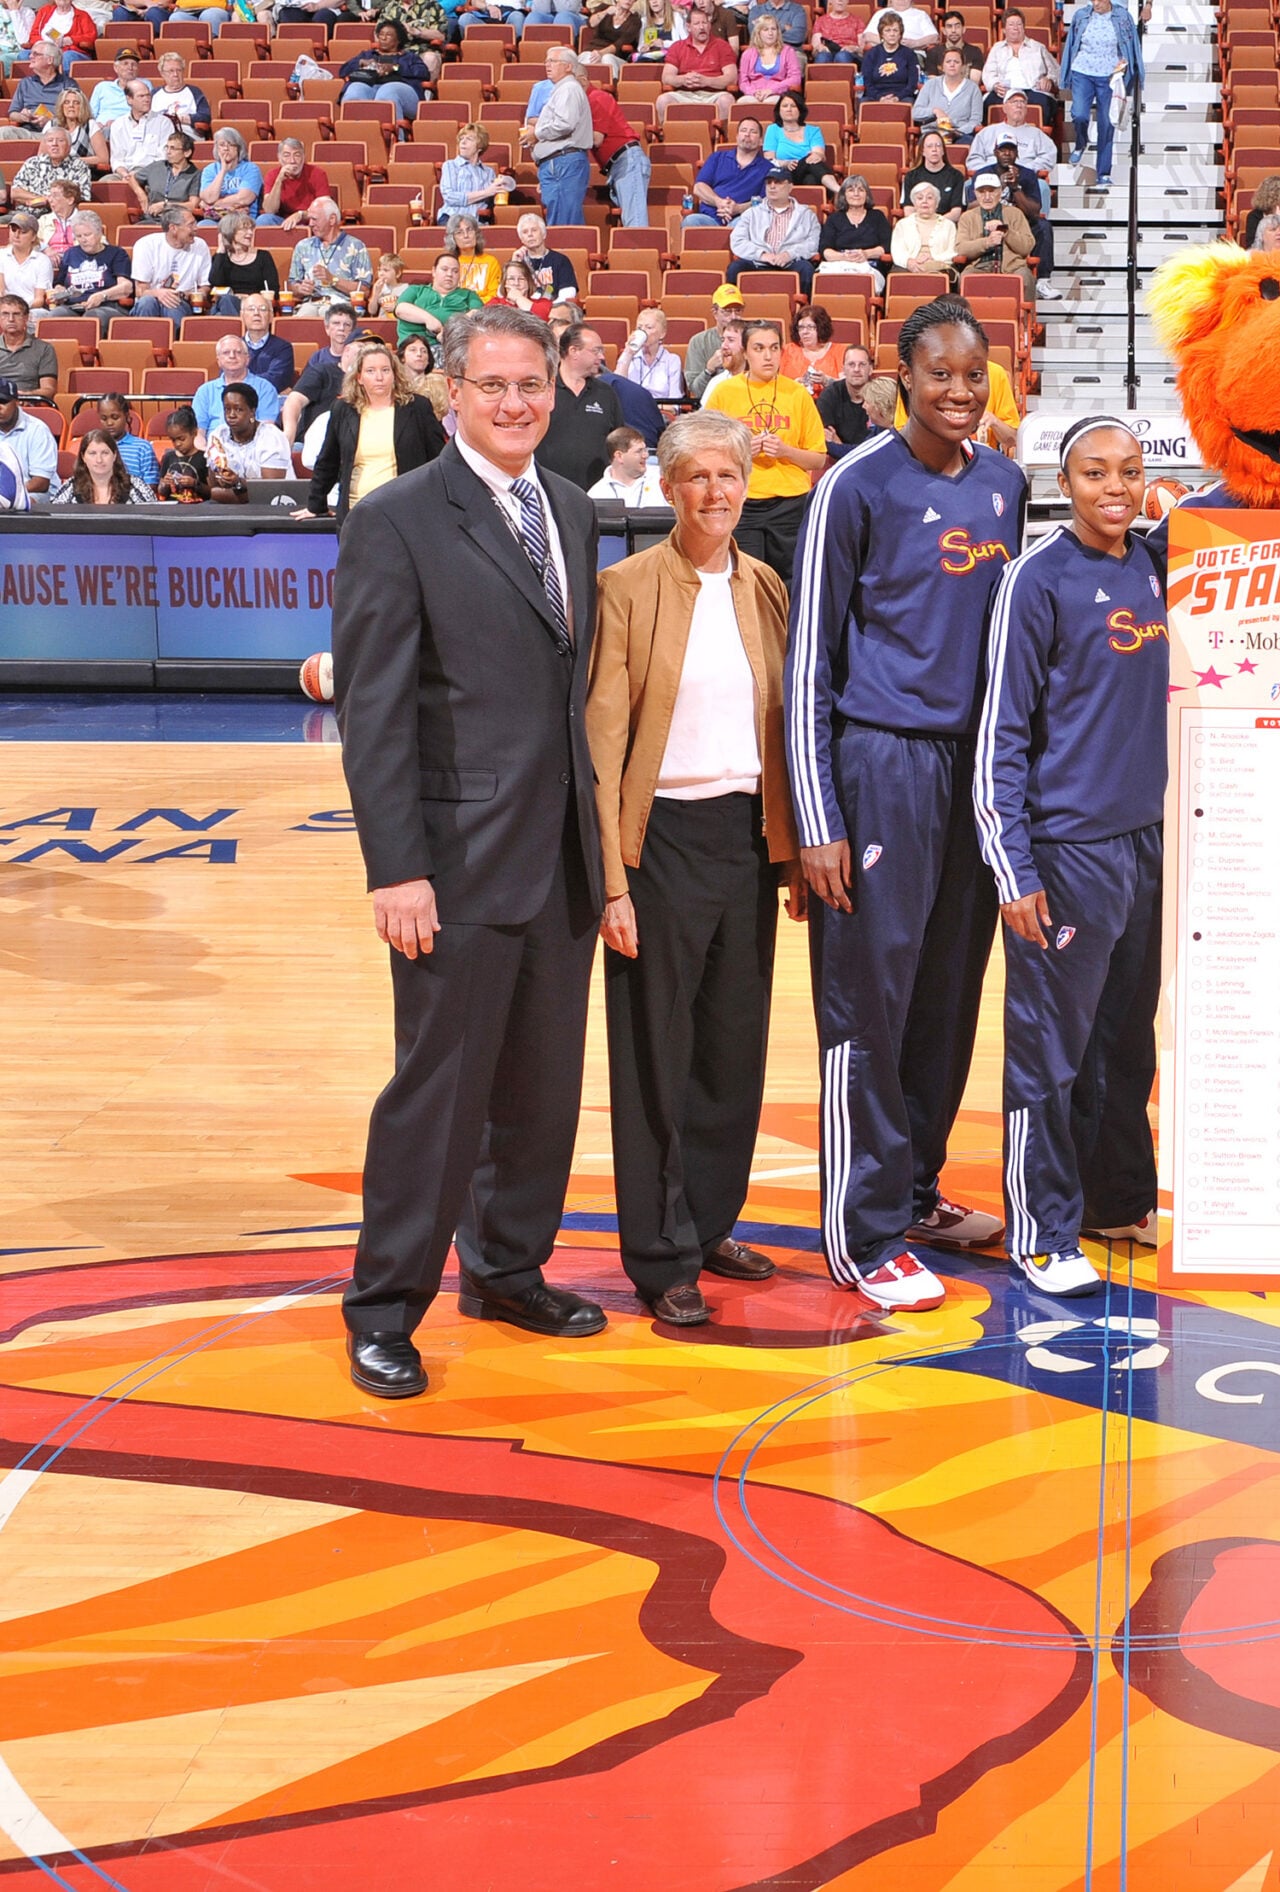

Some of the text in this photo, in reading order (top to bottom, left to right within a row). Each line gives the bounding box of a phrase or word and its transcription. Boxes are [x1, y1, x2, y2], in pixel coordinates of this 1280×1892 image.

[938, 527, 1012, 576] Sun
[1196, 549, 1241, 569] VOTE
[0, 564, 69, 606] AUSE
[75, 564, 160, 607] WE'RE
[168, 566, 298, 609] BUCKLING
[1106, 607, 1168, 655] Sun
[1238, 614, 1280, 627] presented by
[0, 808, 245, 831] AN
